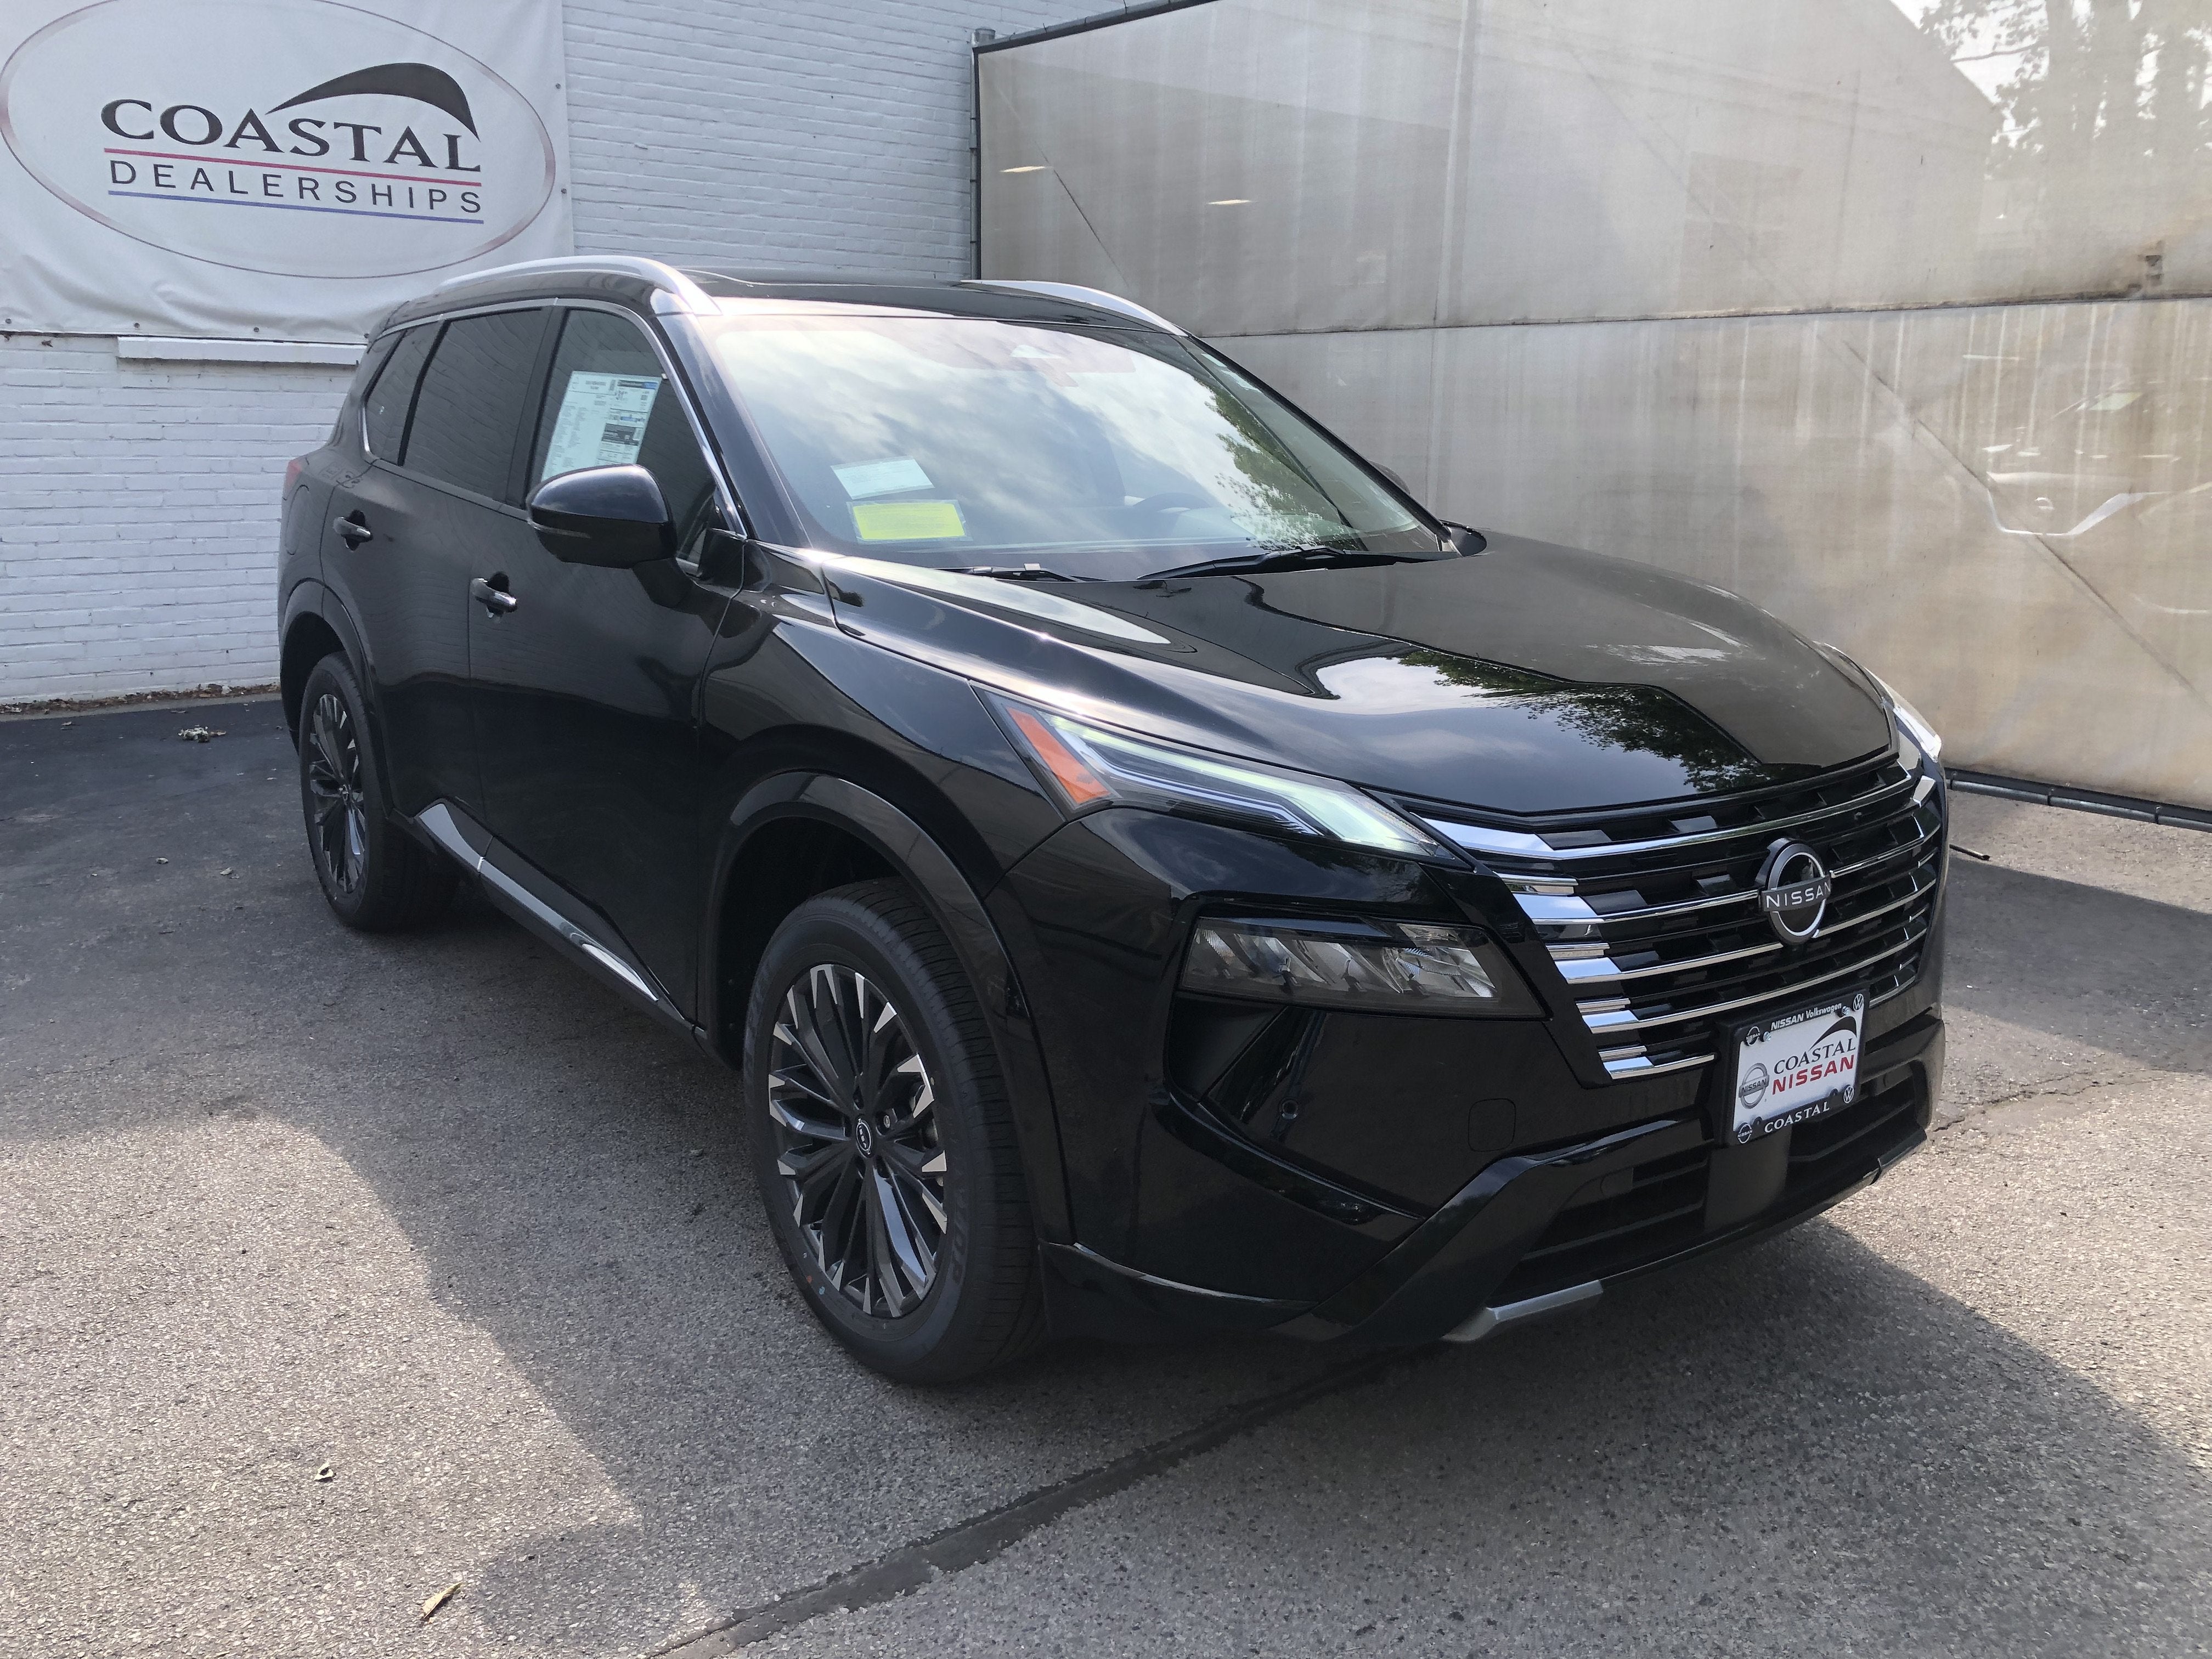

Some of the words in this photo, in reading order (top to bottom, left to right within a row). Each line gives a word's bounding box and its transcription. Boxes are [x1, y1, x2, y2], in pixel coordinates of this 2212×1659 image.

[101, 99, 481, 172] COASTAL
[110, 159, 482, 213] DEALERSHIPS
[1766, 881, 1831, 909] NISSAN
[1770, 1013, 1804, 1031] NISSAN
[1805, 1002, 1842, 1019] Volkswagen
[1774, 1038, 1857, 1074] COASTAL
[1741, 1077, 1767, 1094] NISSAN
[1772, 1054, 1855, 1095] NISSAN
[1764, 1101, 1830, 1133] COASTAL
